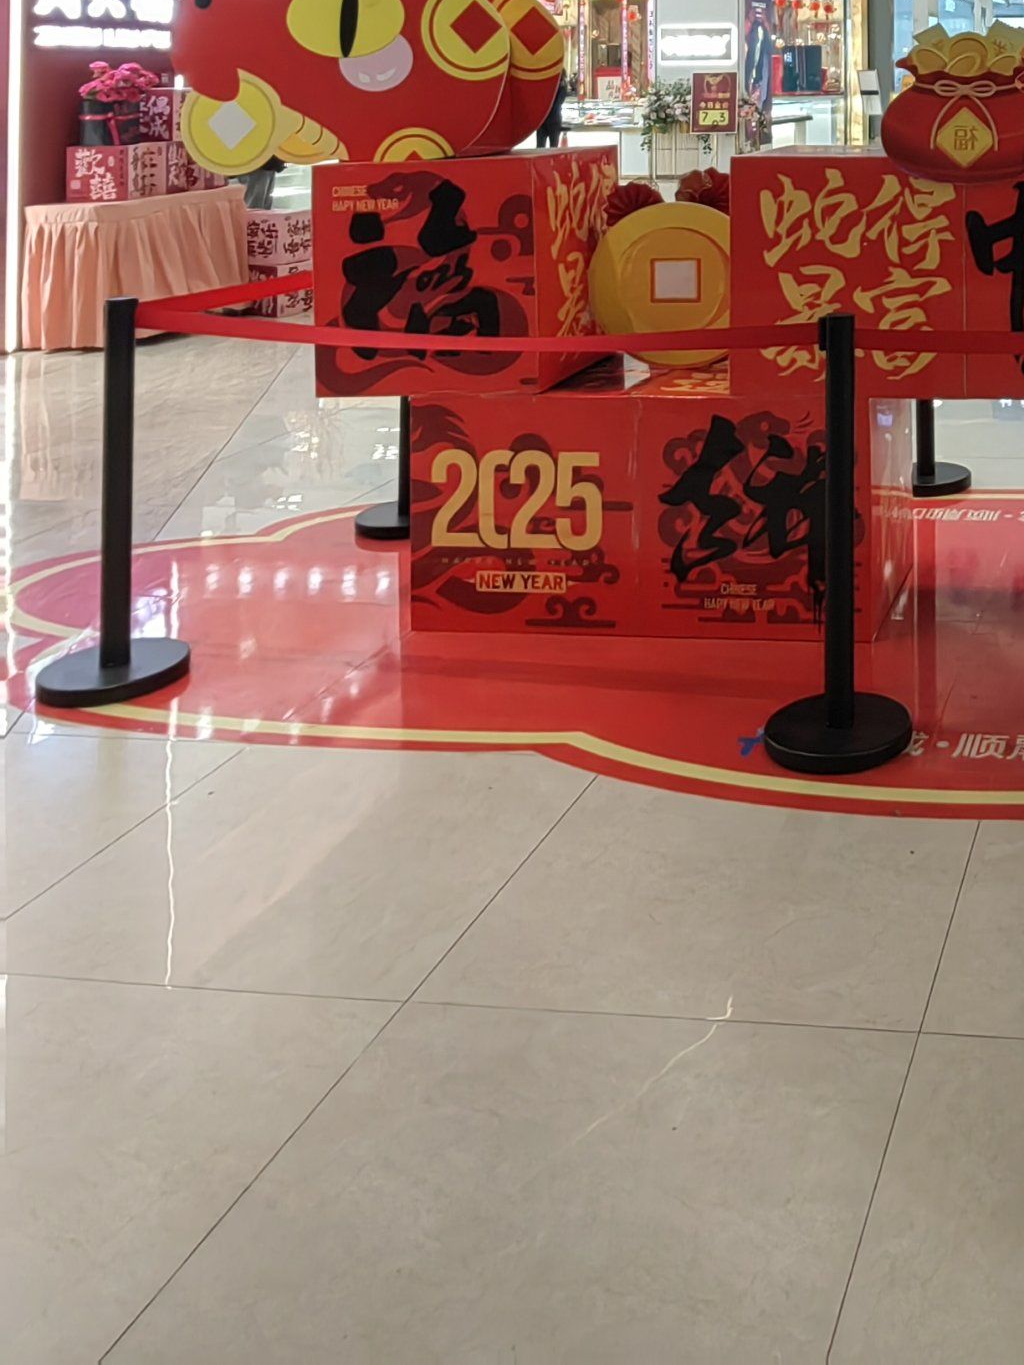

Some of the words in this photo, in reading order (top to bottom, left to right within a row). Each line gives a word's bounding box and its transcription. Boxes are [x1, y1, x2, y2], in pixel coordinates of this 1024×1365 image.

[430, 448, 603, 552] 2025
[478, 573, 516, 590] NEW
[521, 573, 564, 591] YEAR
